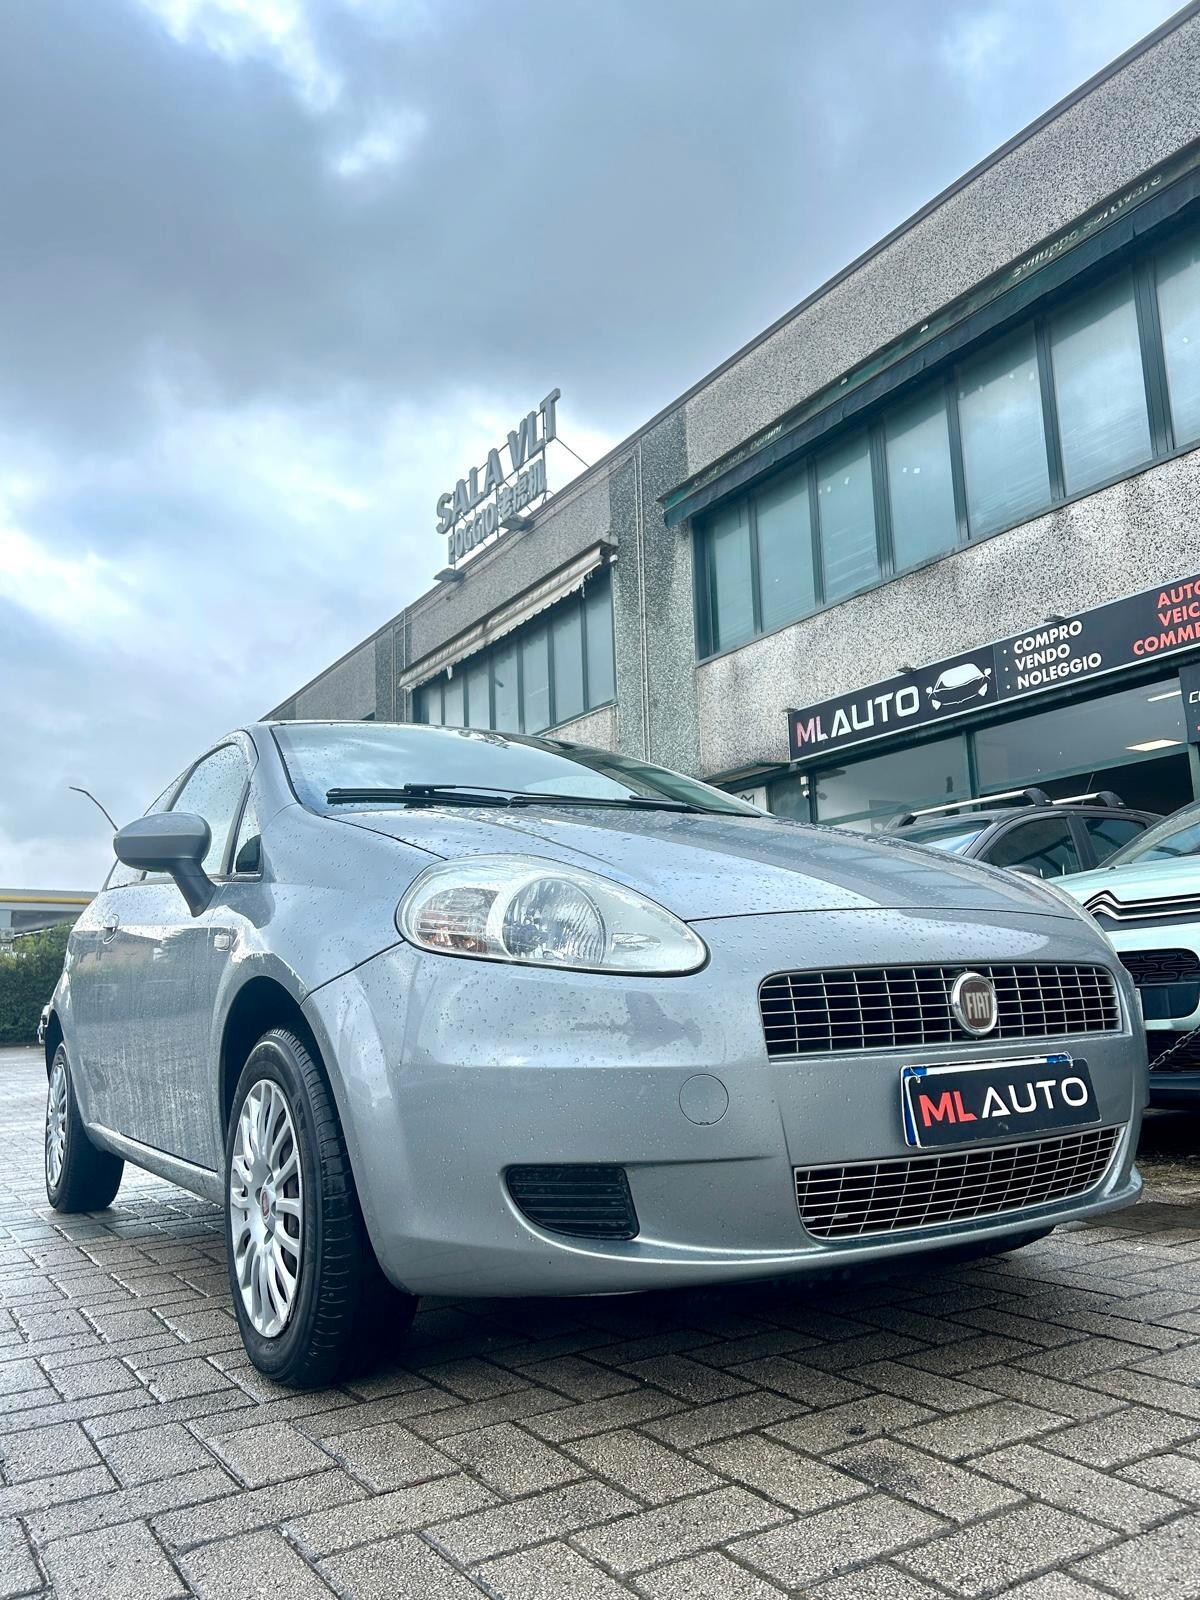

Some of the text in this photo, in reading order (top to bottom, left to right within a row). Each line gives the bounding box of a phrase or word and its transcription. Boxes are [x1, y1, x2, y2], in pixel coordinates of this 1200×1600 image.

[436, 388, 561, 535] SALA VLT
[448, 503, 499, 565] POGGIO
[1013, 620, 1083, 654] COMPRO
[1015, 643, 1071, 672] VENDO
[1017, 652, 1102, 690] NOLEGGIO
[965, 991, 990, 1020] FIAT
